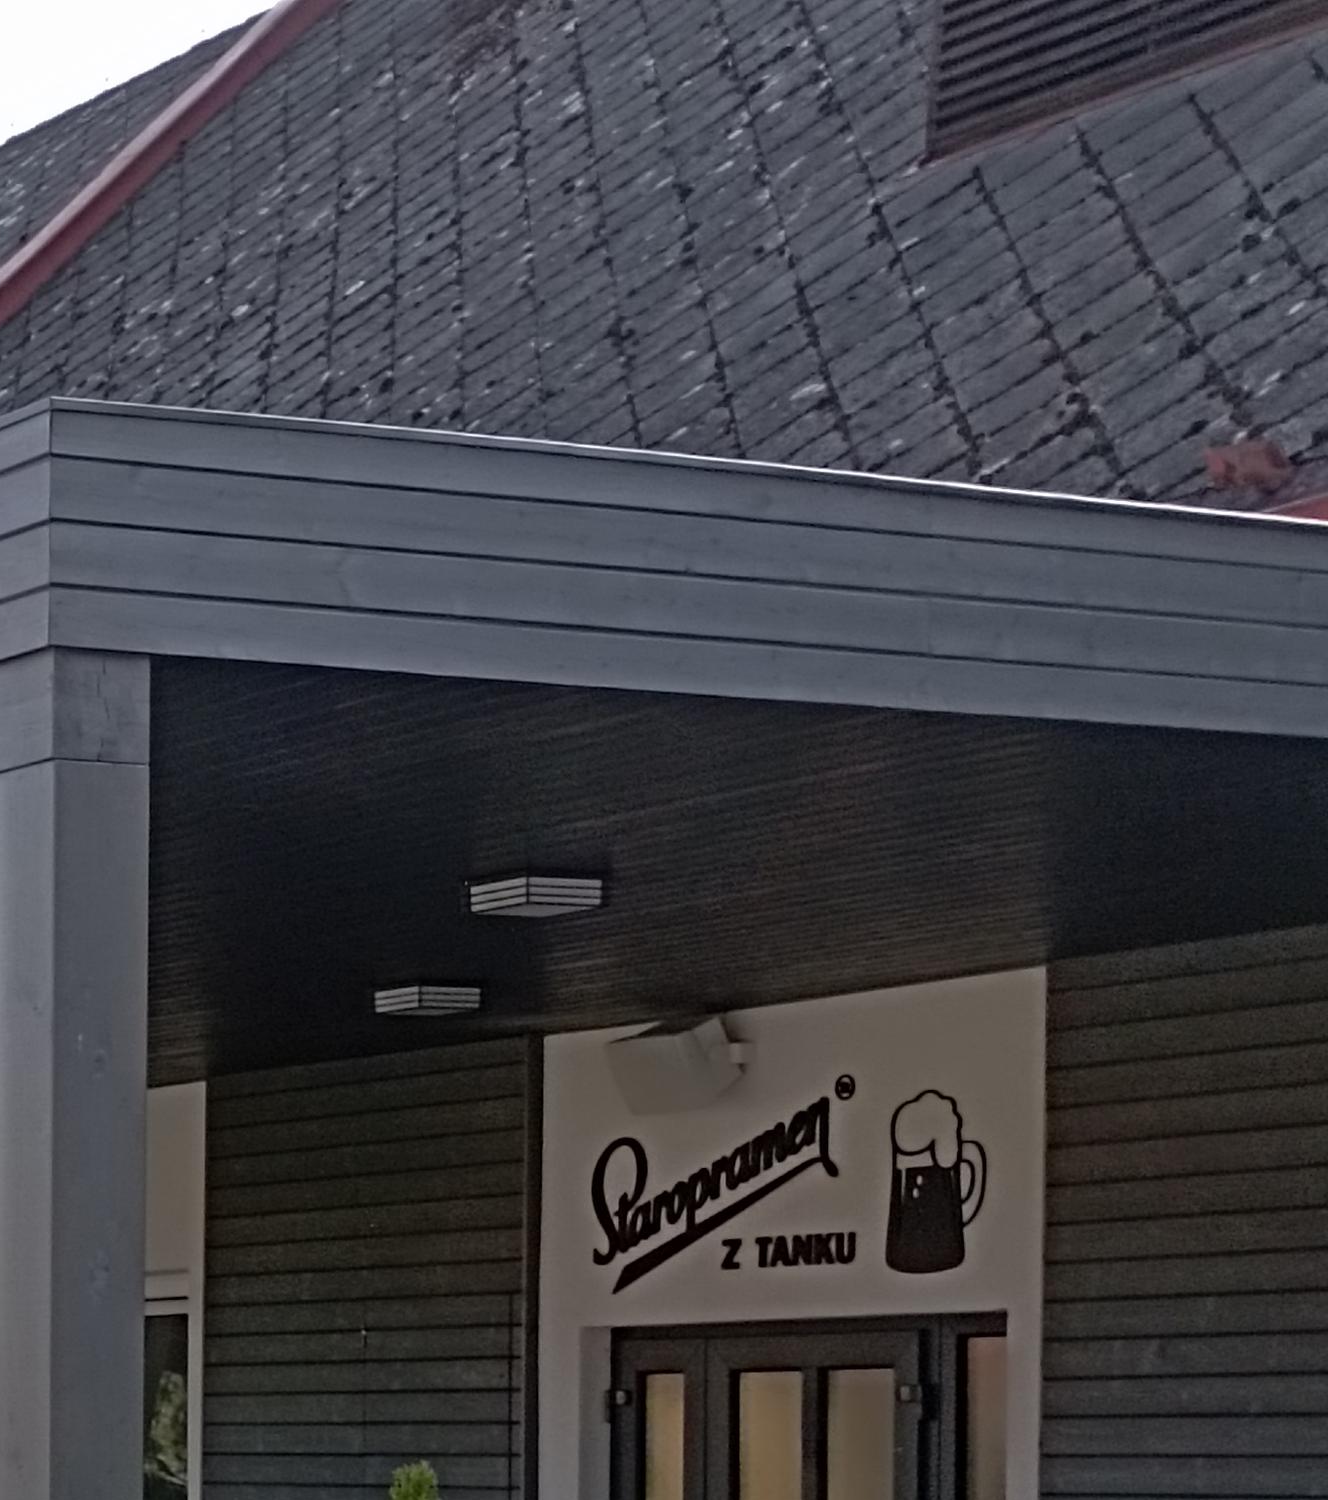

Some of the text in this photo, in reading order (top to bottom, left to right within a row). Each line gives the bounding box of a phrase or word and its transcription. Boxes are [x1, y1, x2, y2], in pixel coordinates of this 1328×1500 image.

[591, 1096, 839, 1293] Staropramen
[721, 1231, 857, 1269] Z TANKU
